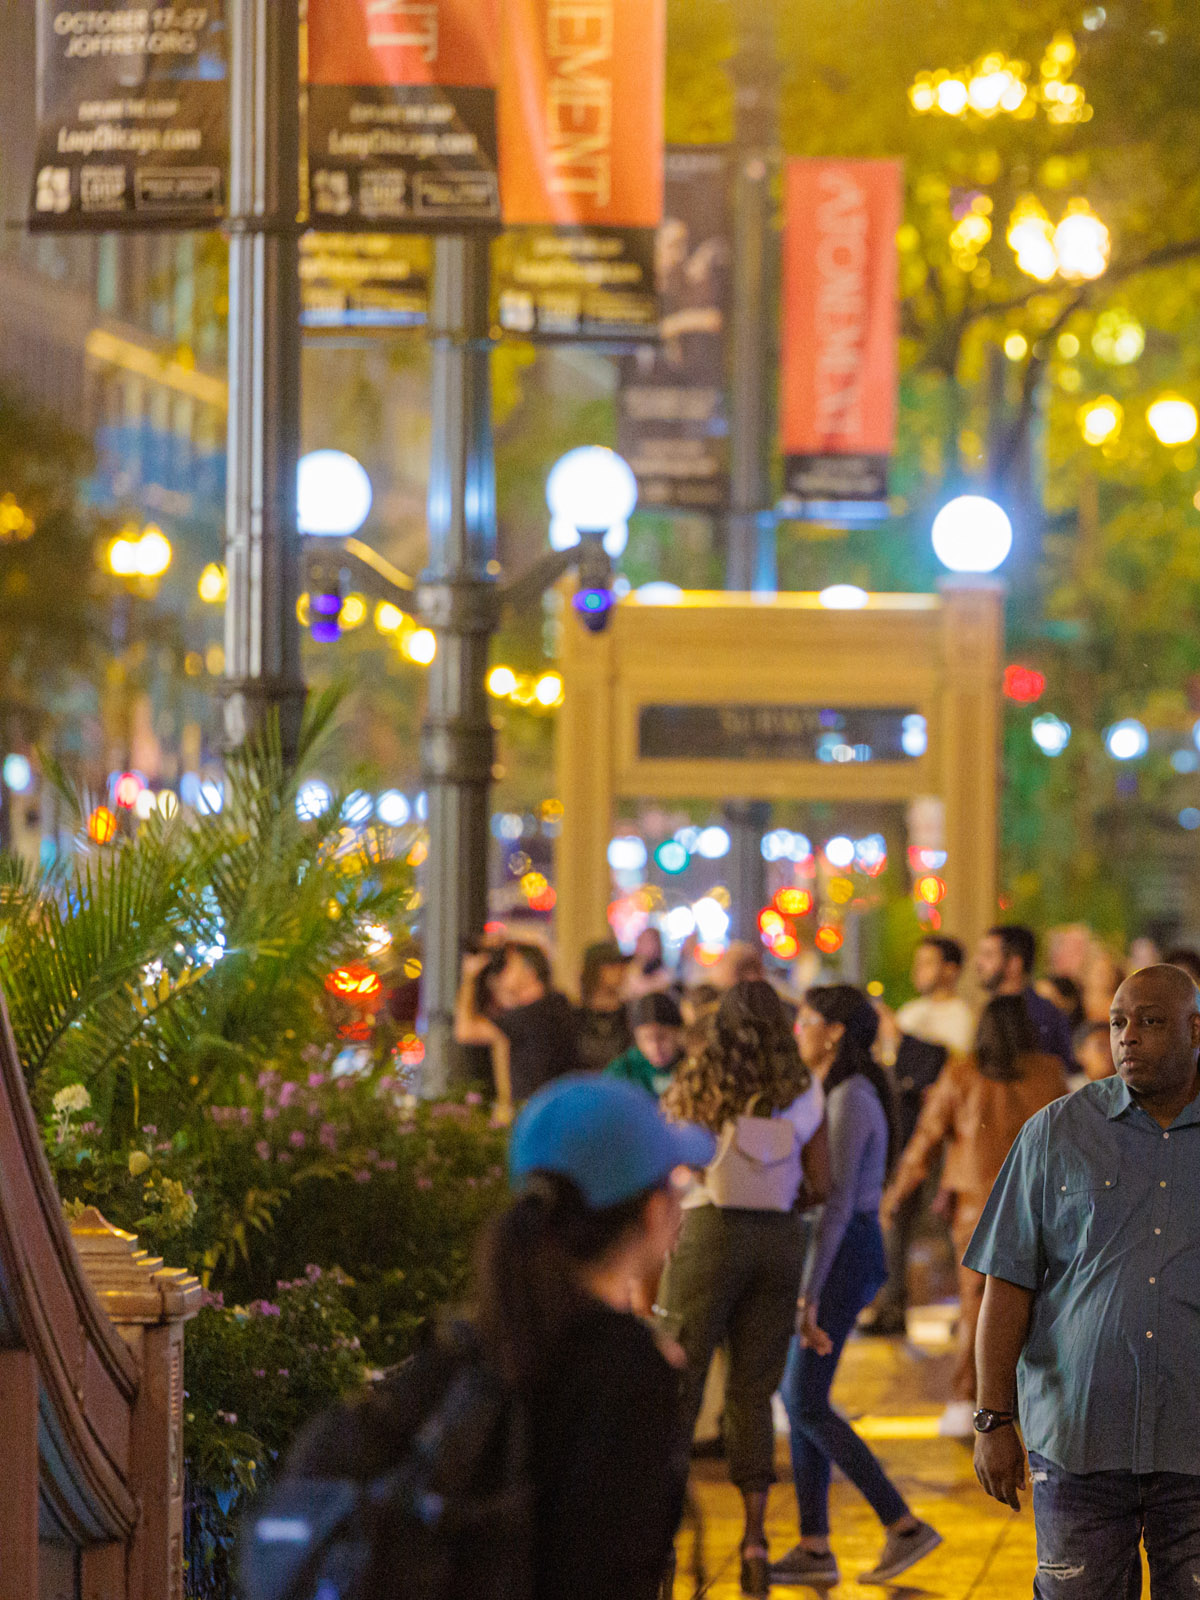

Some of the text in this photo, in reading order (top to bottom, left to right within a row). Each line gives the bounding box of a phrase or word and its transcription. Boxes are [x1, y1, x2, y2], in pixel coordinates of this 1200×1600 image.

[54, 7, 208, 35] OCTOBER 17-27
[65, 31, 198, 57] JOFFREY.ORG
